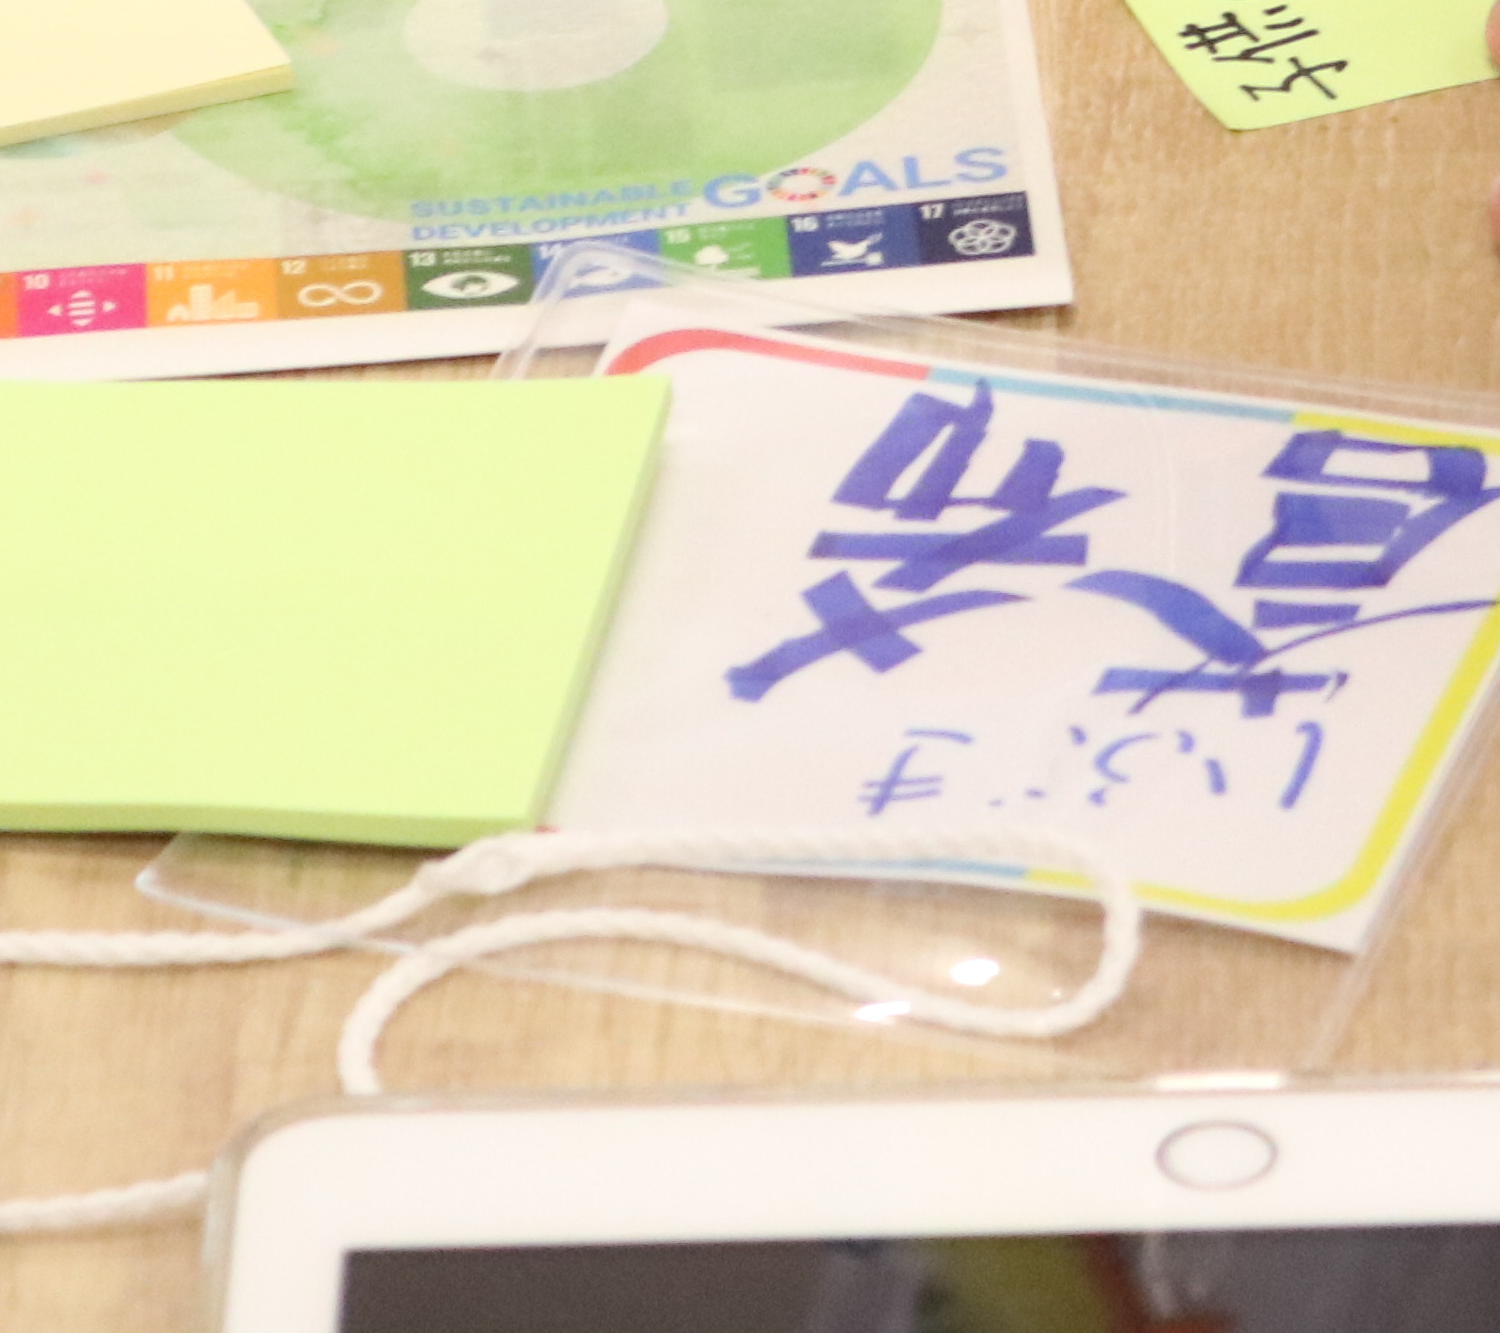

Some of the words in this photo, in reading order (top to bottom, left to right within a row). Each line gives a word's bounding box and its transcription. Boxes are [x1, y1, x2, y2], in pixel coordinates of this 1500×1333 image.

[702, 145, 1009, 209] GOALS
[410, 178, 693, 219] SUSTAINABLE
[410, 202, 693, 242] DEVELOPMENT
